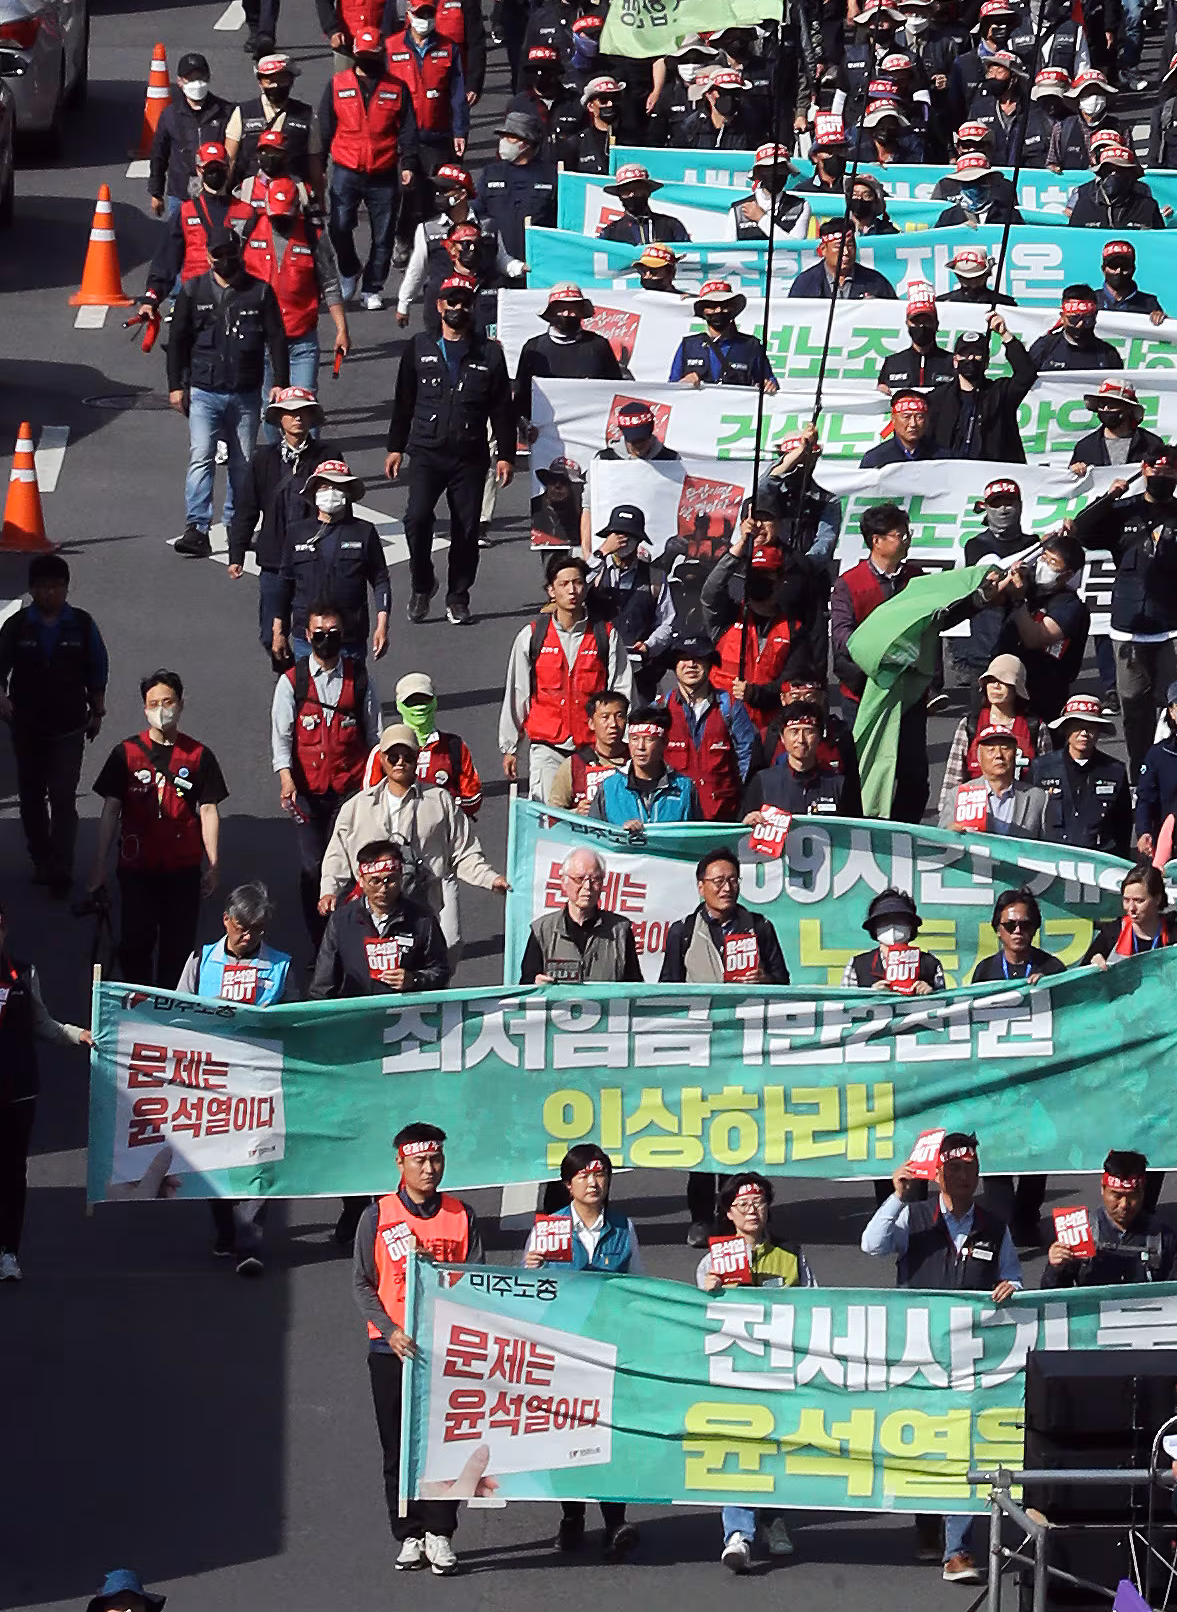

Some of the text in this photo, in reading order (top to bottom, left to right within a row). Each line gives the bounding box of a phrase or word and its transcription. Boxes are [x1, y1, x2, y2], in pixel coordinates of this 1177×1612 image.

[956, 803, 989, 822] OUT
[753, 824, 784, 844] OUT
[366, 954, 398, 972] OUT
[726, 953, 757, 973] OUT
[886, 963, 917, 981] OUT
[220, 983, 256, 1001] OUT
[381, 997, 713, 1076] 최저임금
[127, 1043, 230, 1091] 문제는
[127, 1095, 276, 1149] 윤석열이다
[541, 1082, 896, 1169] 인상하라!
[536, 1231, 569, 1252] OUT
[1057, 1223, 1088, 1247] OUT
[712, 1252, 746, 1275] OUT
[442, 1324, 556, 1387] 문제는
[704, 1299, 1070, 1392] 전세사기
[443, 1389, 601, 1444] 윤석열이다
